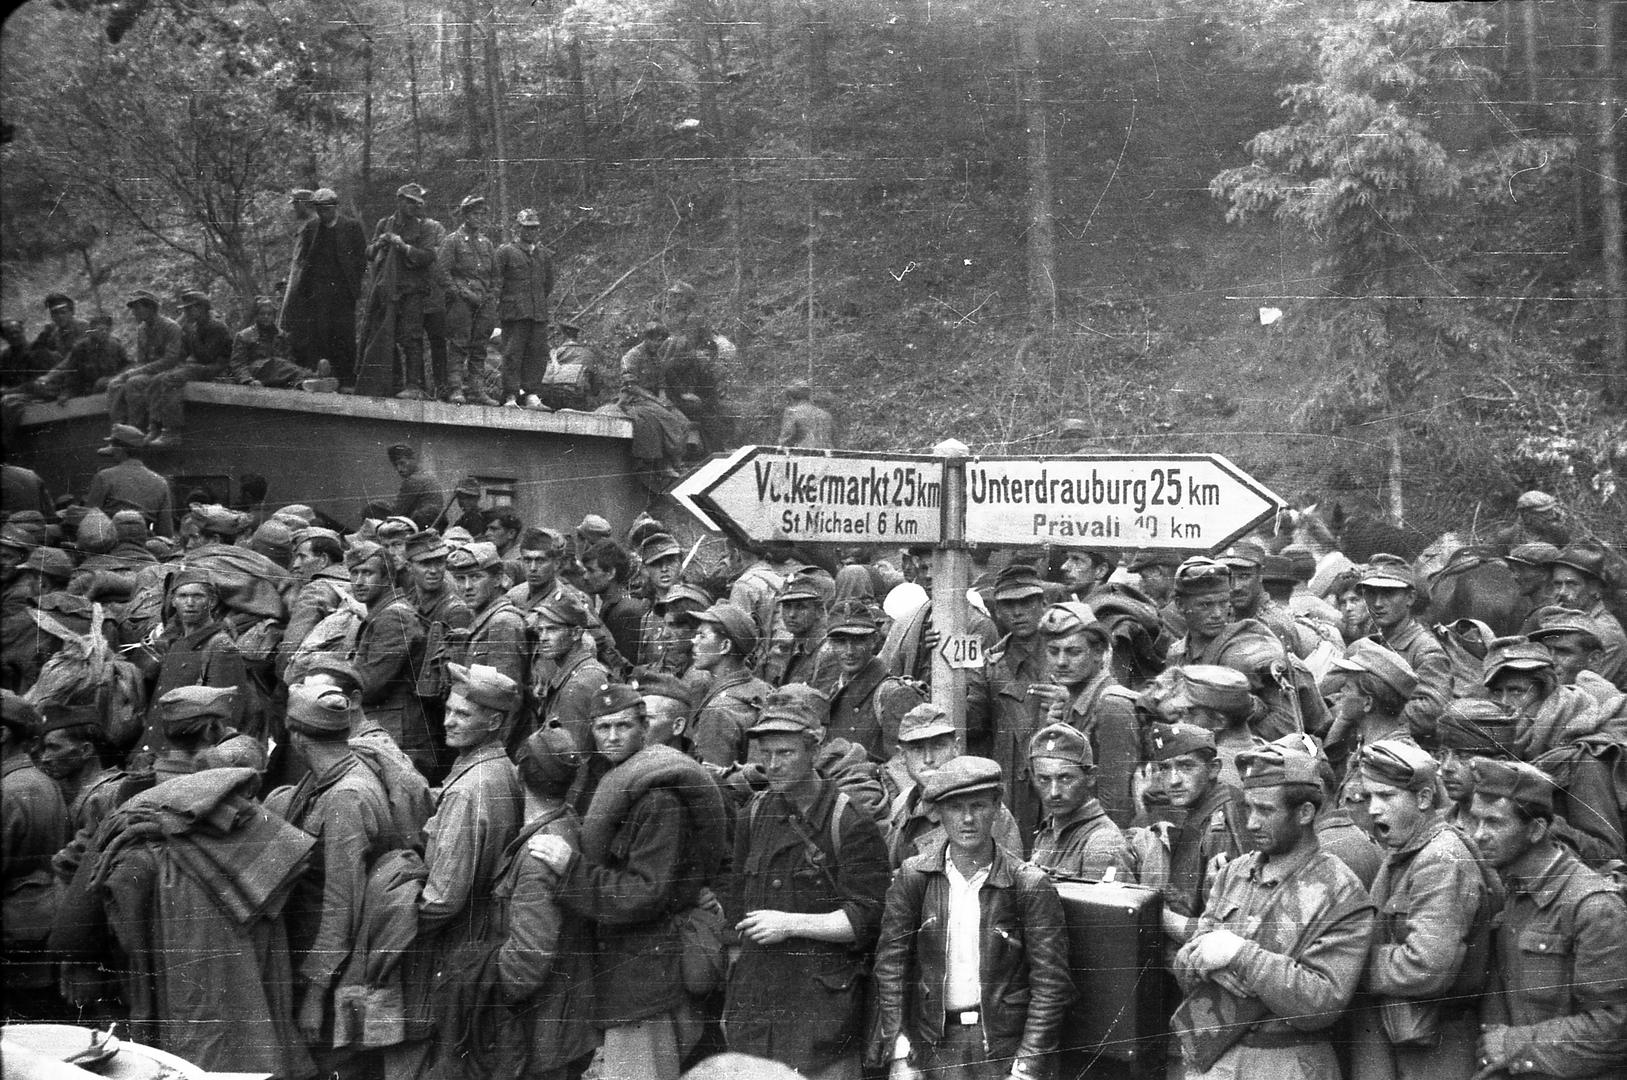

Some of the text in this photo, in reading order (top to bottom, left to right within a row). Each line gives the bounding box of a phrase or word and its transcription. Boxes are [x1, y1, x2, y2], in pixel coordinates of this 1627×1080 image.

[892, 467, 916, 508] 25
[917, 473, 941, 509] km
[970, 468, 1220, 513] Unterdrauburg 25 km
[805, 512, 870, 535] Michael
[877, 512, 887, 535] 6
[895, 512, 918, 535] km
[1032, 513, 1120, 538] Prävali
[1170, 516, 1201, 539] km
[954, 640, 977, 662] 216
